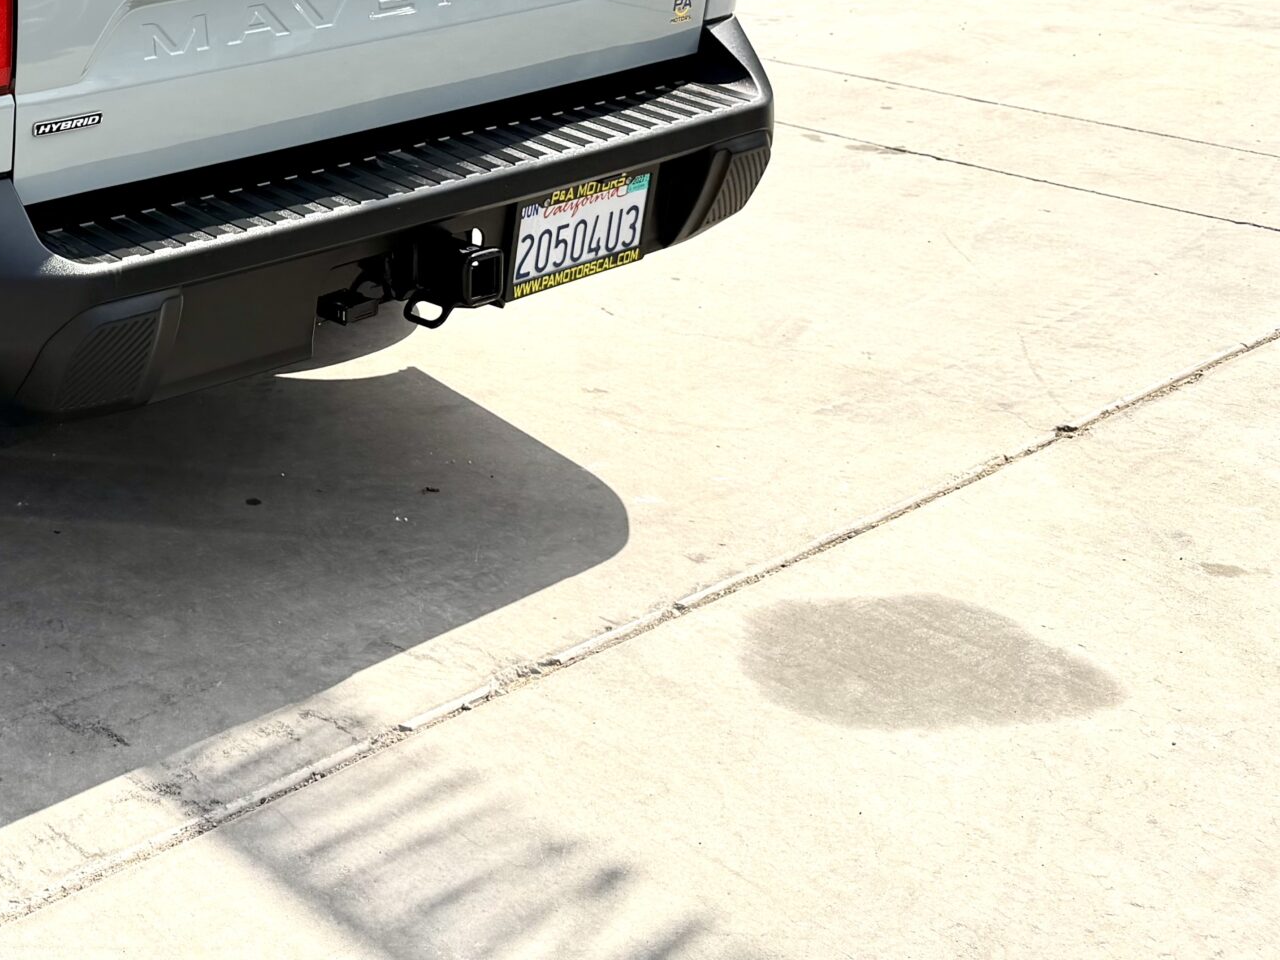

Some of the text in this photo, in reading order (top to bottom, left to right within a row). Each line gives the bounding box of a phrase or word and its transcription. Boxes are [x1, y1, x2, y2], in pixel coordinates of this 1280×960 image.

[38, 115, 100, 134] HYBRID
[543, 187, 621, 219] California
[550, 186, 575, 205] P&A
[577, 176, 626, 196] MOTORS
[521, 203, 539, 220] JUN
[515, 204, 640, 281] 20504U3
[513, 248, 640, 299] WWW.PAMOTORSCAL.COM
